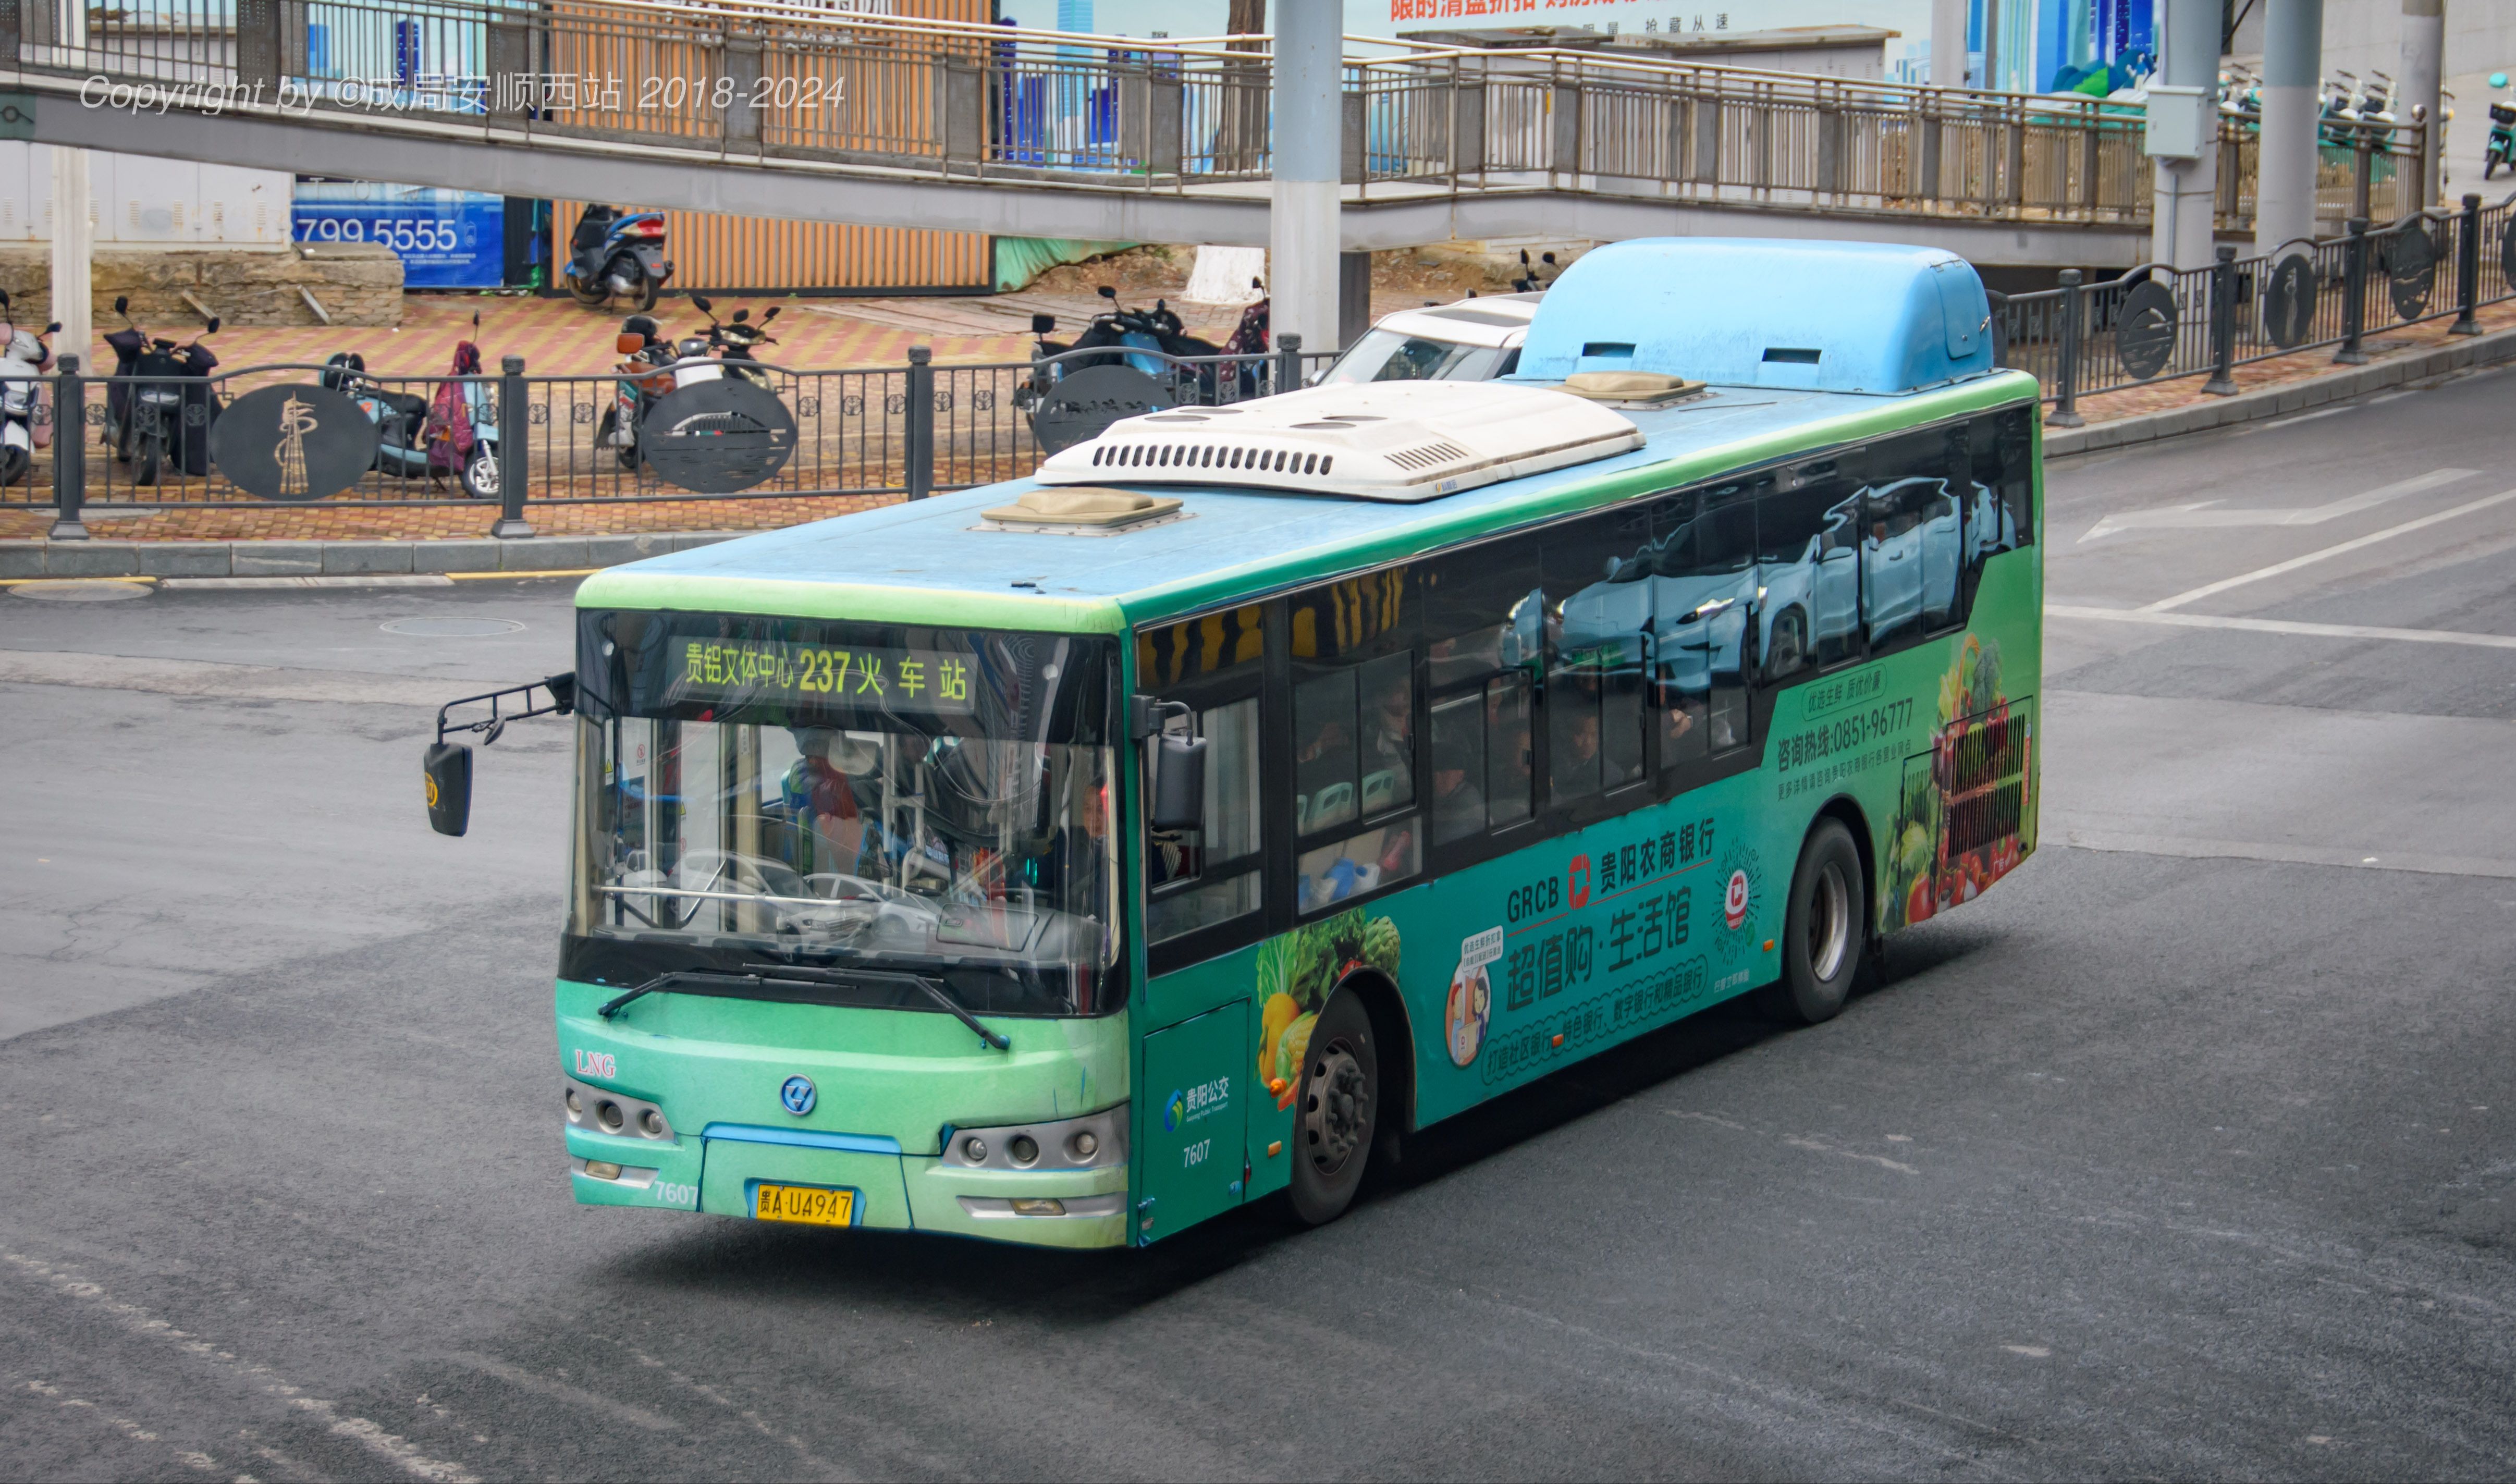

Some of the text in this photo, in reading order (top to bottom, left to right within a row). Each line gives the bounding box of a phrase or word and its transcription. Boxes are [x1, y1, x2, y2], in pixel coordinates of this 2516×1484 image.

[373, 219, 457, 251] 5555
[686, 643, 966, 700] 贵铝文体中心 237 火车站
[1808, 670, 1881, 713] 优选生鲜 质优价廉
[1507, 817, 1714, 923] GRCB 贵阳农商银行
[1487, 965, 1703, 1077] 打造社区银行特色银行、数字银行和精品银行
[575, 1049, 616, 1078] LNG
[1186, 1075, 1229, 1113] 贵阳公交
[1183, 1138, 1210, 1168] 7607
[655, 1181, 699, 1206] 7607
